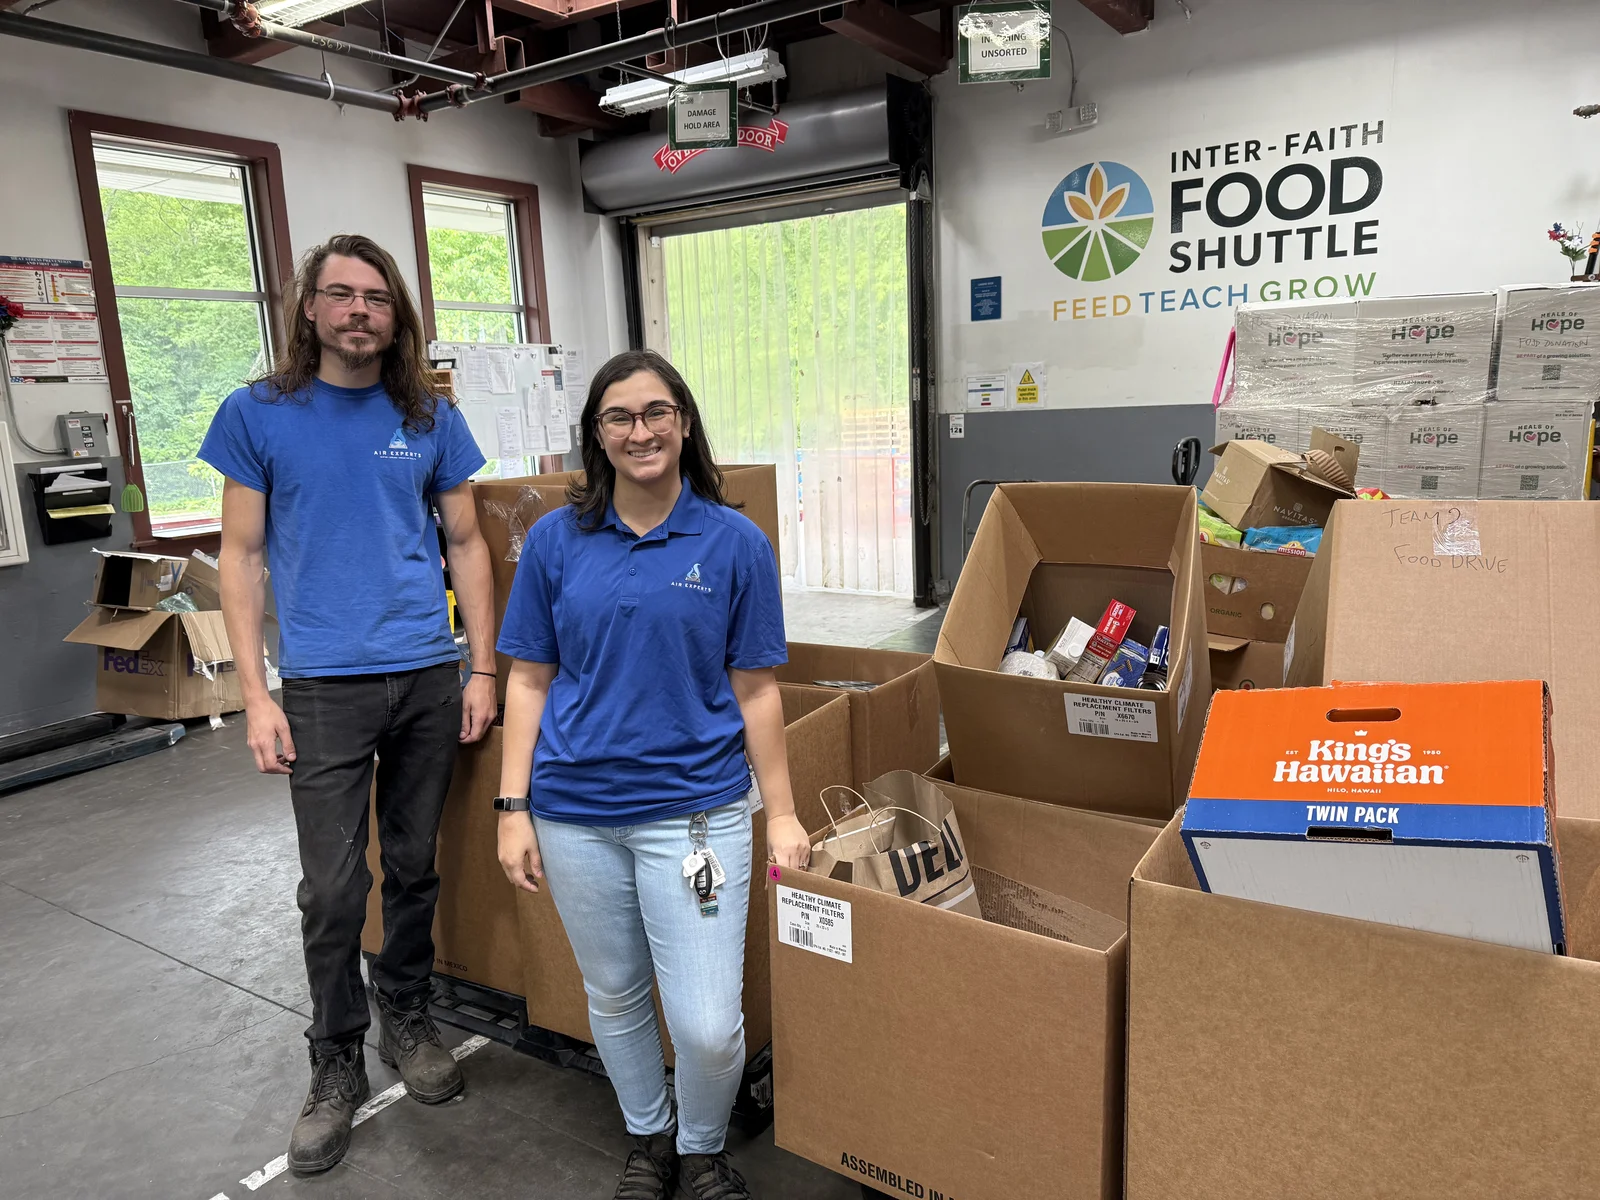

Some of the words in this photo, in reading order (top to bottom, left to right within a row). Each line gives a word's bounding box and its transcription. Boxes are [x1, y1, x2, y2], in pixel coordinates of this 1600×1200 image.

[981, 47, 1027, 58] UNSORTED
[687, 108, 717, 117] DAMAGE
[684, 121, 701, 130] HOLD
[702, 120, 720, 129] AREA
[737, 130, 772, 147] DOOR
[1171, 120, 1384, 173] INTER-FAITH
[1170, 156, 1384, 234] FOOD
[1168, 219, 1380, 274] SHUTTLE
[1053, 294, 1131, 322] FEED
[1139, 283, 1249, 314] TEACH
[1259, 272, 1377, 303] GROW
[1391, 325, 1455, 344] Hope
[1531, 318, 1585, 334] Hope
[1410, 432, 1459, 447] Hope
[1509, 430, 1562, 446] Hope
[1273, 505, 1316, 524] NAVITAS
[1382, 508, 1440, 528] TEAM
[1393, 543, 1442, 568] FOOD
[1451, 554, 1509, 574] DRIVE
[684, 582, 712, 592] EXPERTS
[1210, 607, 1242, 618] ORGANIC
[104, 649, 164, 676] FedEx
[1073, 702, 1121, 712] REPLACEMENT
[1082, 696, 1112, 704] HEALTHY
[1114, 700, 1144, 708] CLIMATE
[1308, 738, 1412, 764] King's
[1306, 805, 1348, 822] TWIN
[1354, 806, 1400, 824] PACK
[782, 896, 820, 913] REPLACEMENT
[822, 908, 845, 920] FILTERS
[792, 892, 816, 904] HEALTHY
[817, 898, 842, 910] CLIMATE
[801, 912, 810, 920] P/N
[444, 961, 468, 972] MEXICO
[840, 1152, 924, 1199] ASSEMBLED
